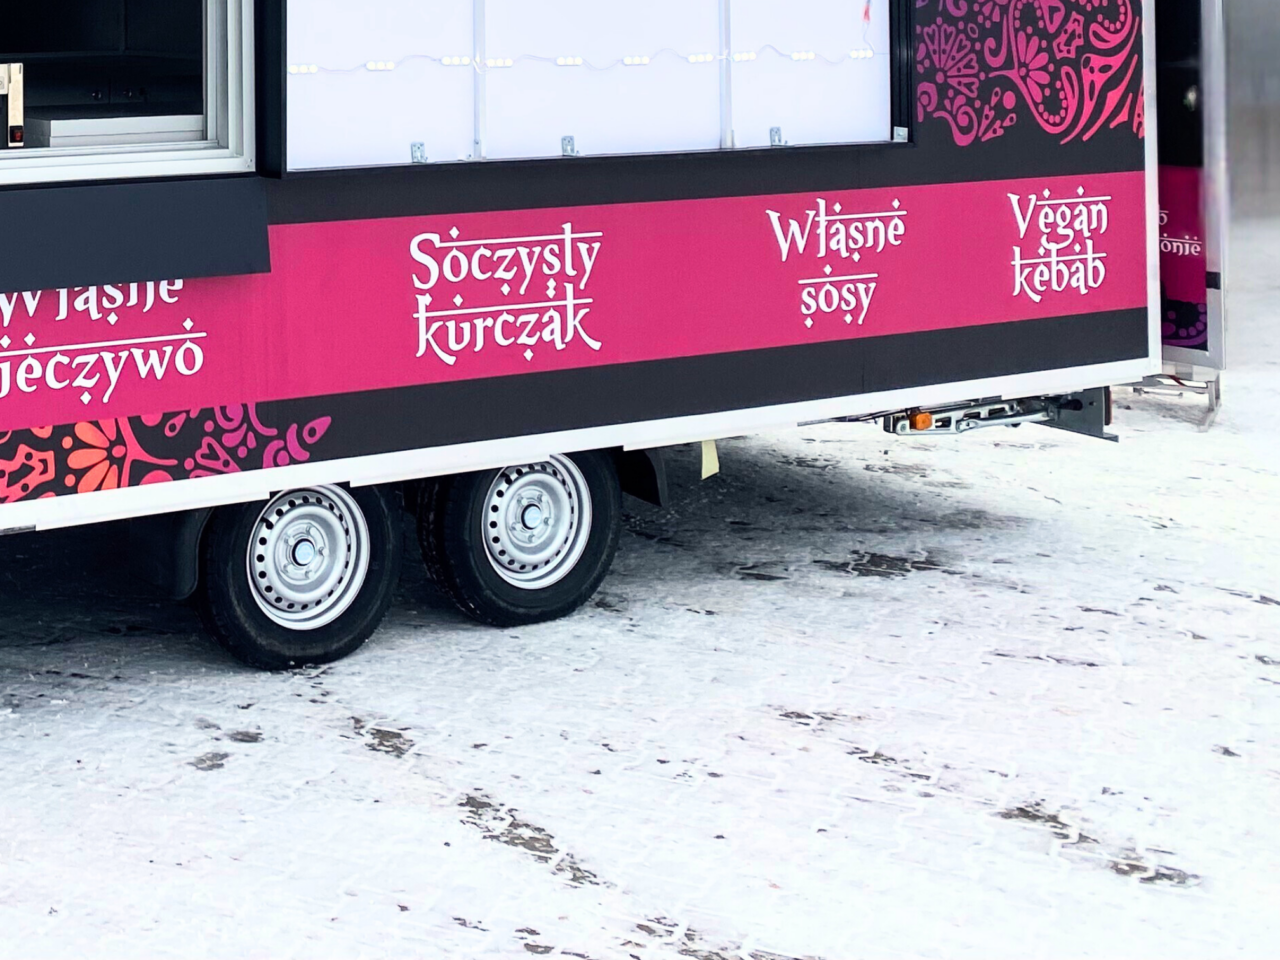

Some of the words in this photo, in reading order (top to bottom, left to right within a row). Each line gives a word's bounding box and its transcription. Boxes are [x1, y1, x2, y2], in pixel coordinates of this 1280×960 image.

[766, 198, 907, 262] Własne
[1007, 186, 1111, 249] Vegan
[410, 222, 603, 295] Soczysty
[1011, 239, 1106, 302] kebab
[413, 283, 602, 365] kurczak
[798, 264, 878, 328] sosy
